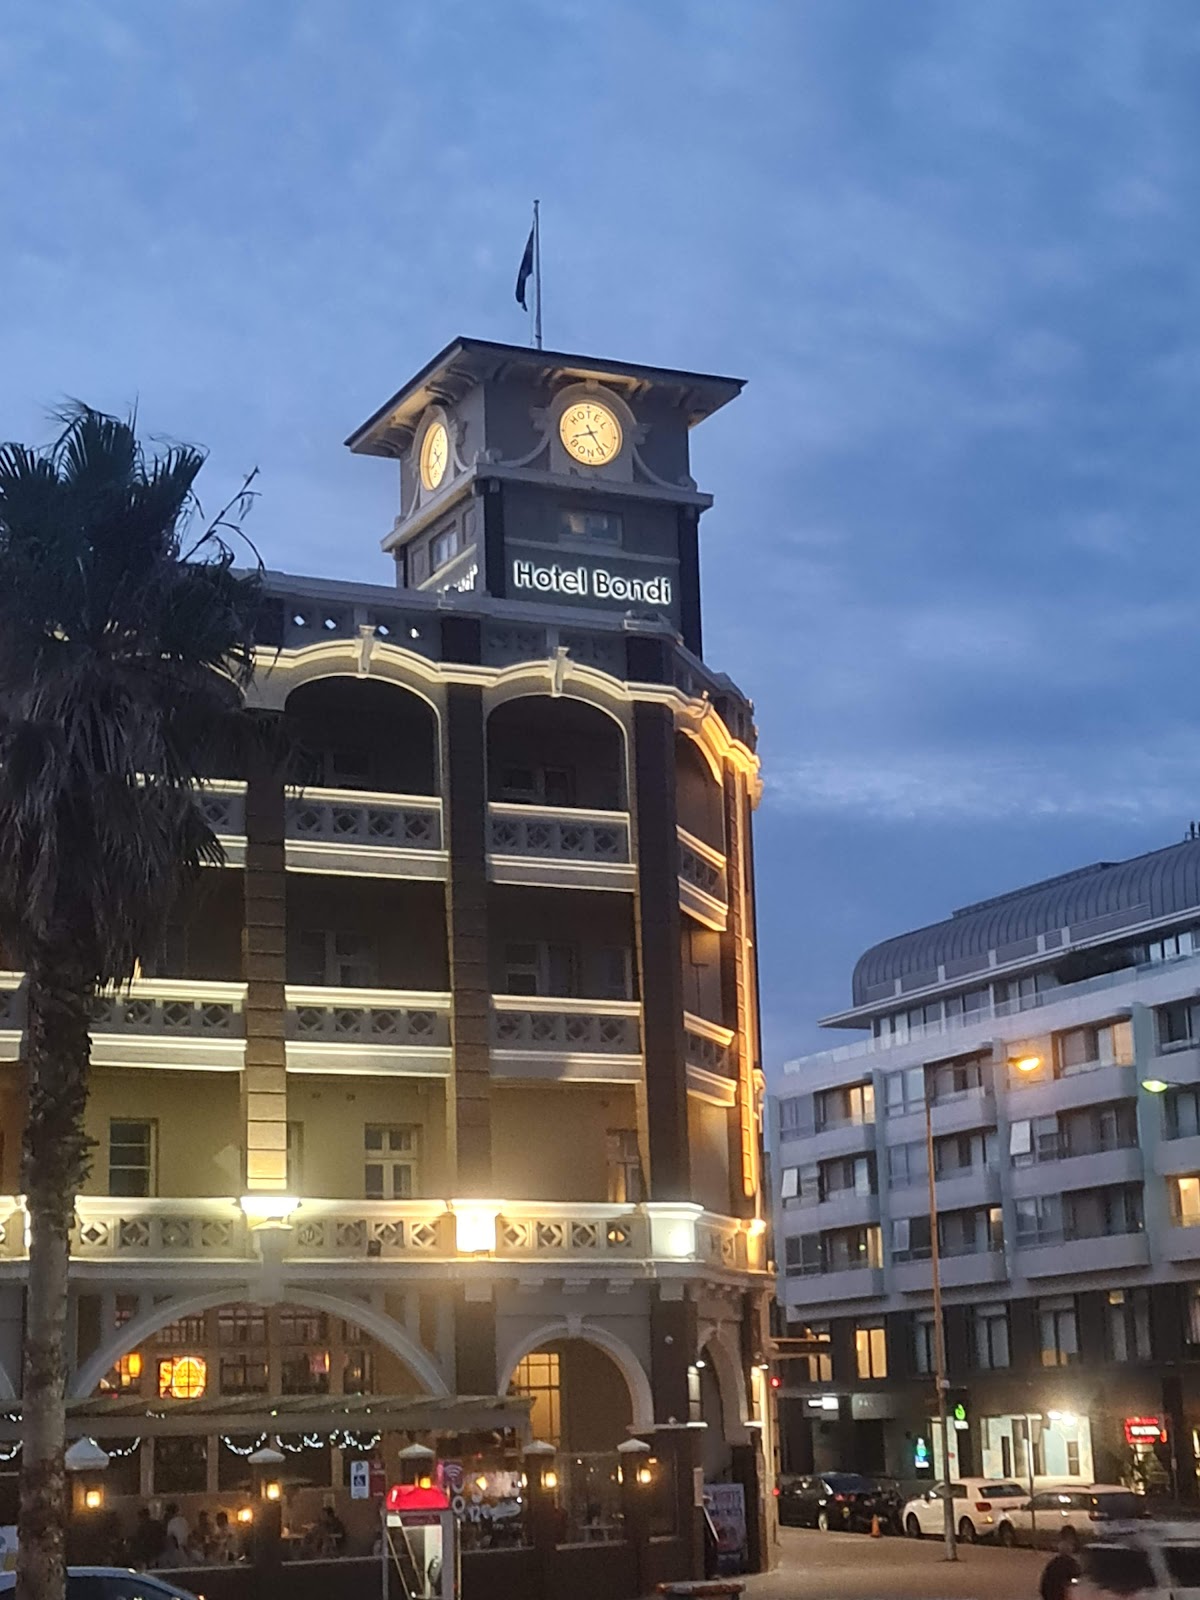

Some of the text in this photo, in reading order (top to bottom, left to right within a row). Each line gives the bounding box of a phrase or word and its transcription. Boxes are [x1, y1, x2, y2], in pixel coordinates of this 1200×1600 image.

[570, 410, 607, 430] HOTEL
[570, 438, 609, 457] BONDI
[514, 560, 588, 594] Hotel
[593, 569, 671, 604] Bondi
